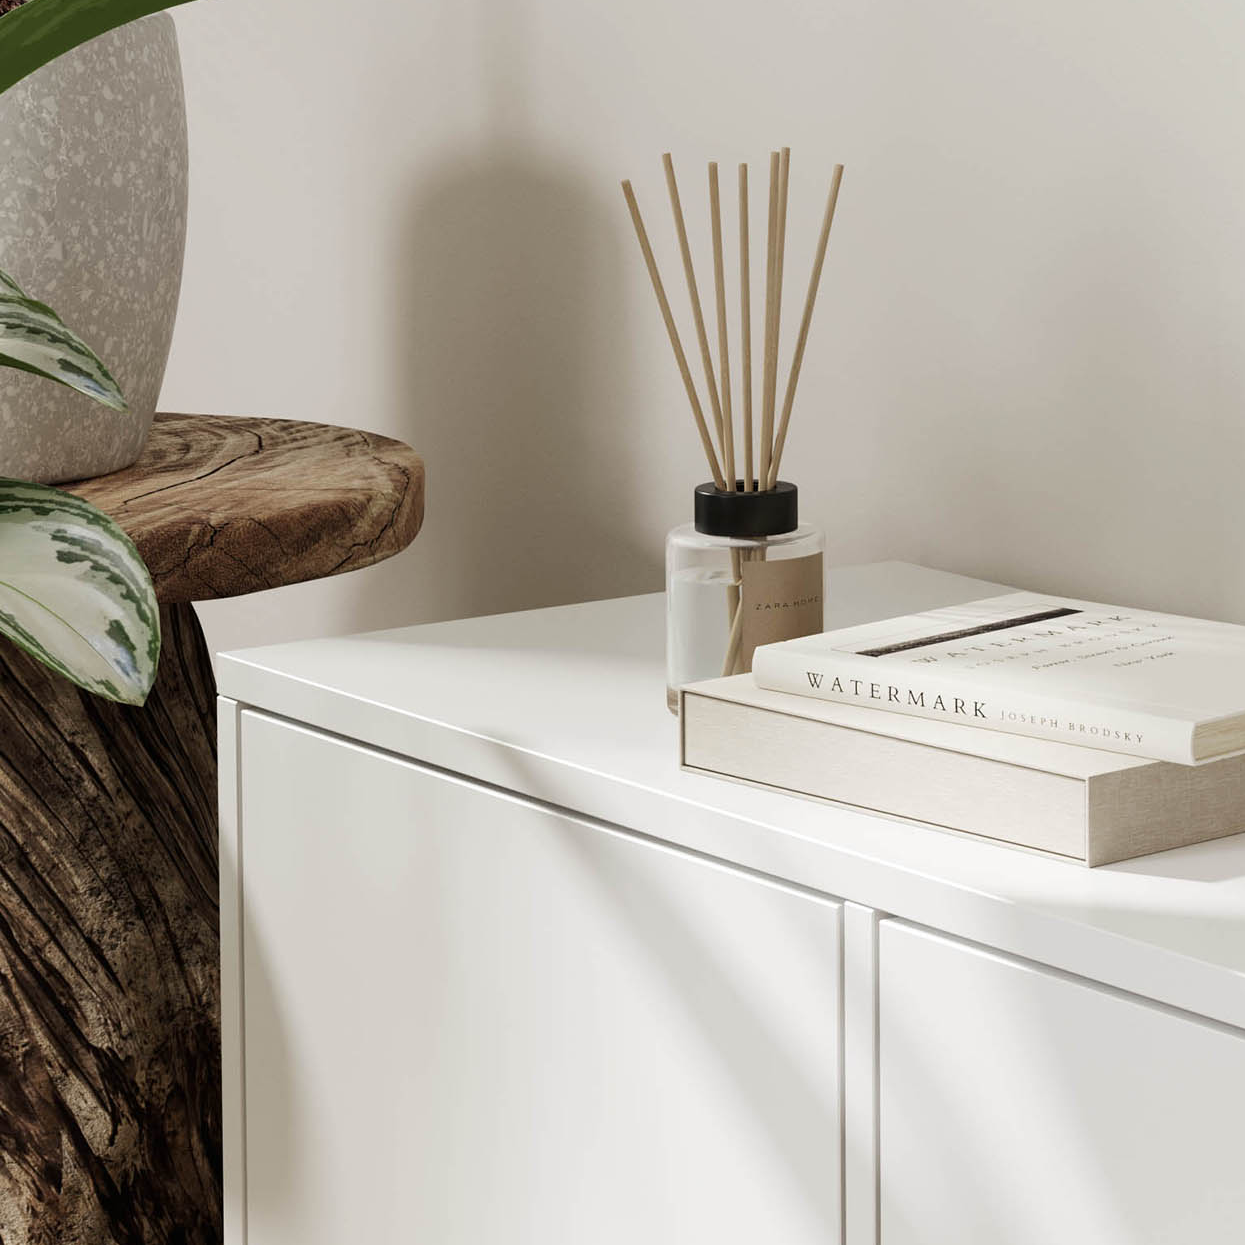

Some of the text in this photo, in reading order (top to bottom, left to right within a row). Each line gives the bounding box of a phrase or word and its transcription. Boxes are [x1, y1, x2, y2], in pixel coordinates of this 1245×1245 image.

[755, 602, 789, 611] ZARA
[806, 672, 1144, 744] WATERMARK JOSEPH BRODSKY
